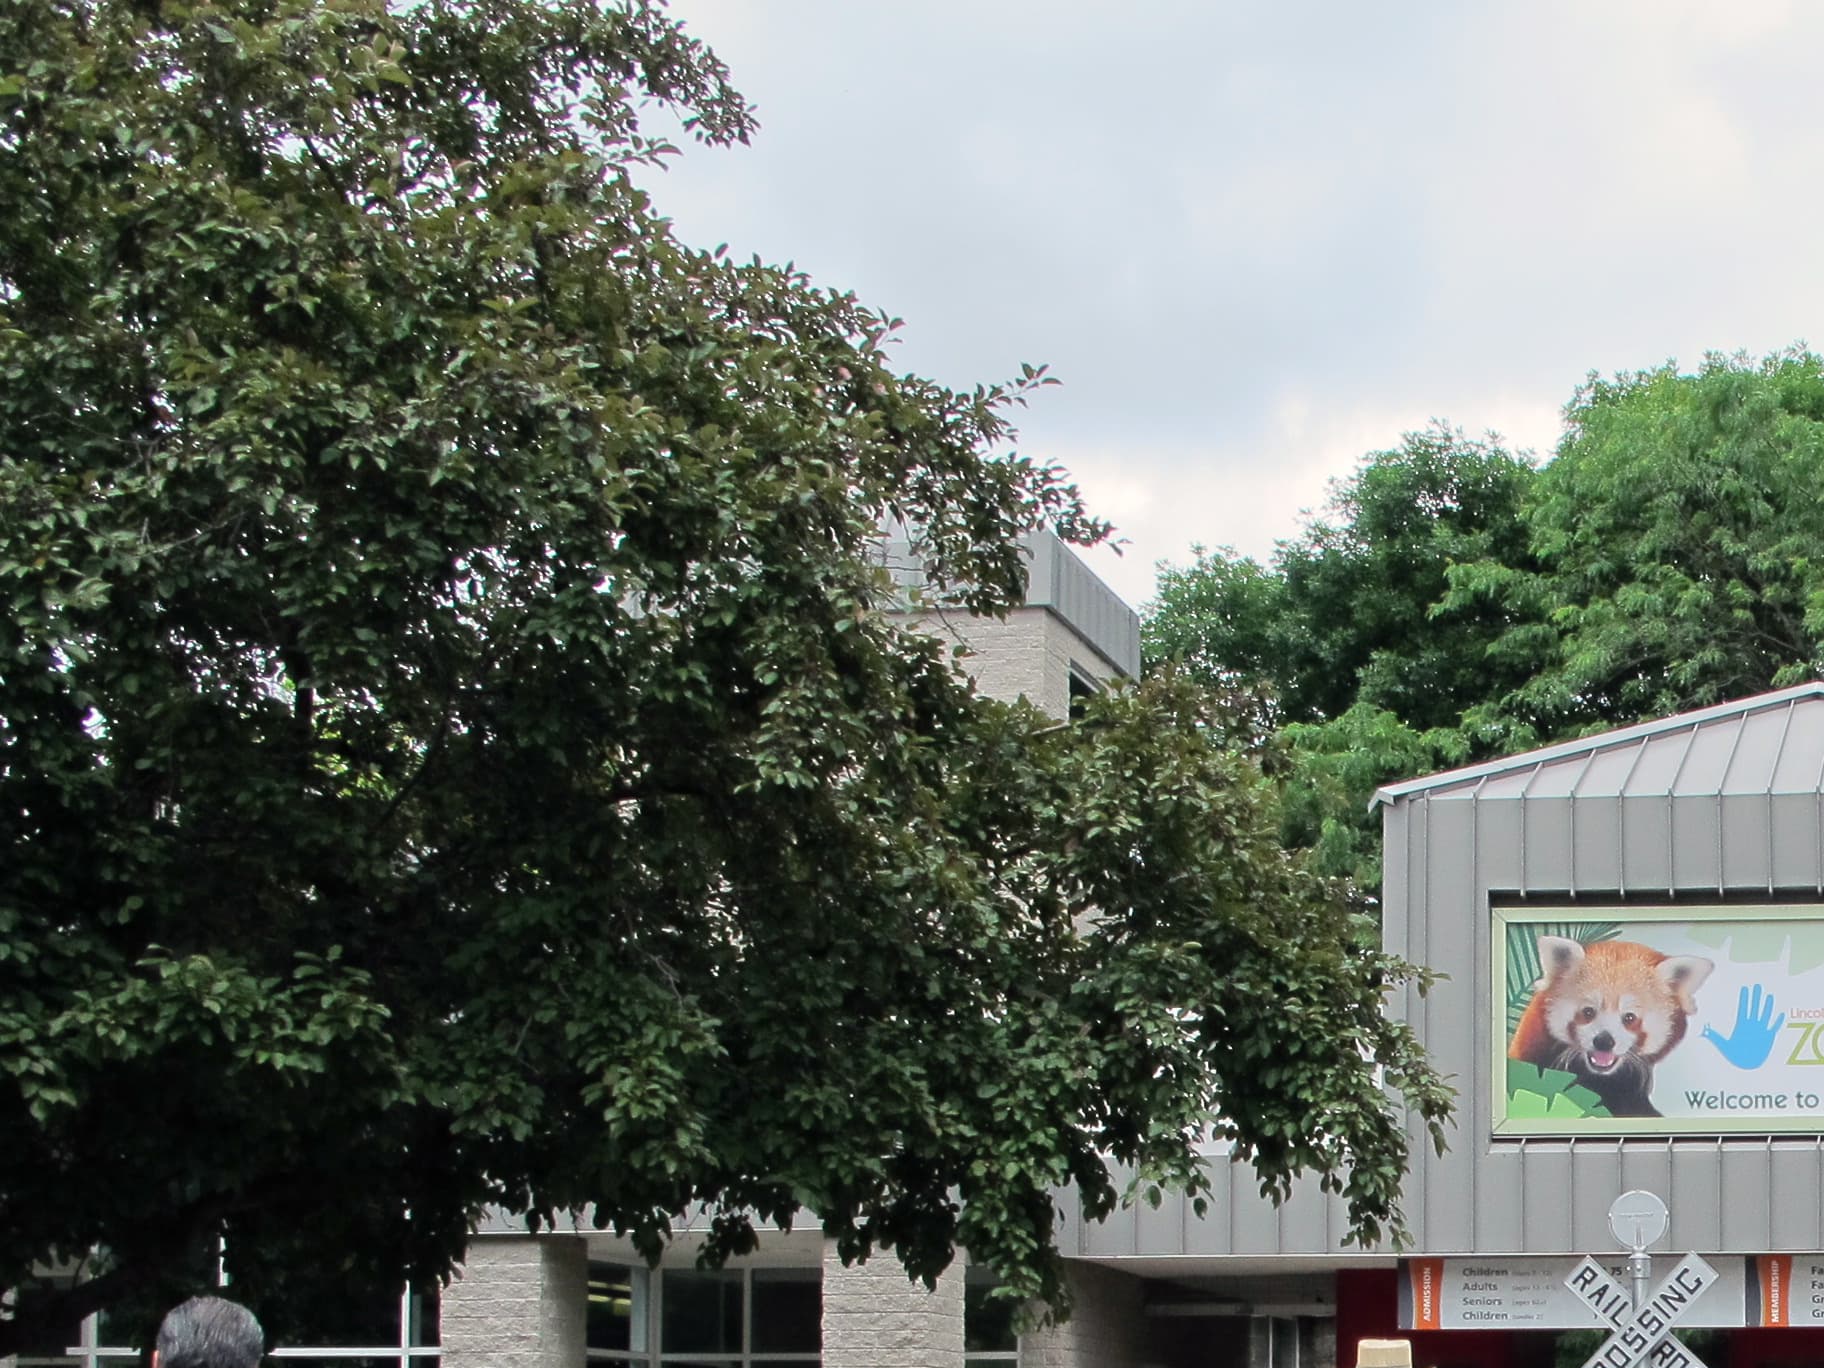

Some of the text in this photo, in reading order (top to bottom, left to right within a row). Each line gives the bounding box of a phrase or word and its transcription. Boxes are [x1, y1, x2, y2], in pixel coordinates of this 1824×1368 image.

[1684, 1090, 1788, 1110] Welcome
[1796, 1092, 1820, 1109] to
[1462, 1267, 1509, 1277] Children
[1462, 1282, 1498, 1291] Adults
[1771, 1260, 1780, 1323] MEMBERSHIP
[1423, 1267, 1431, 1322] ADMISSION
[1462, 1297, 1503, 1306] Seniors
[1572, 1265, 1629, 1327] RAIL
[1462, 1311, 1508, 1320] Children
